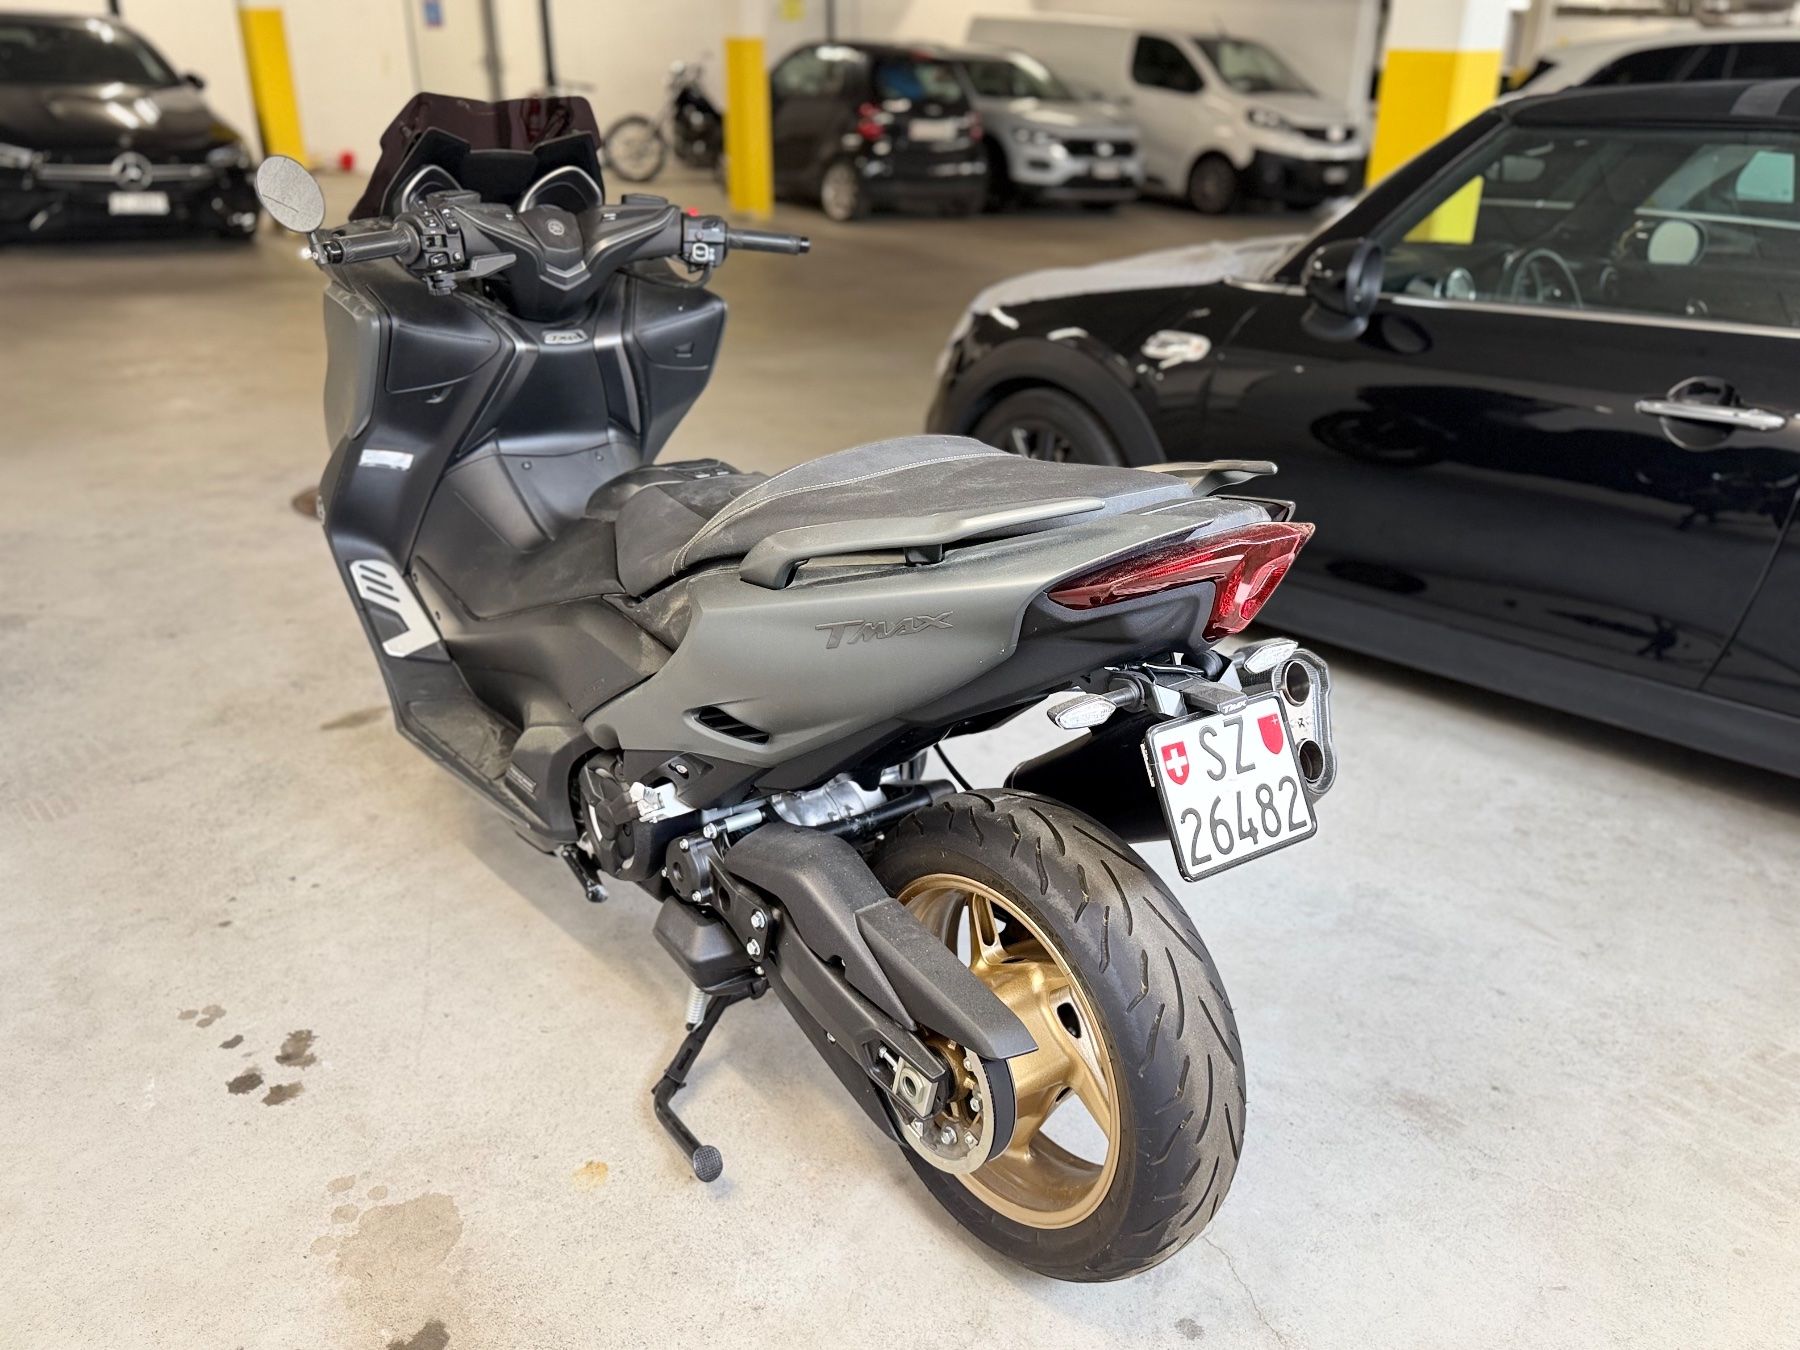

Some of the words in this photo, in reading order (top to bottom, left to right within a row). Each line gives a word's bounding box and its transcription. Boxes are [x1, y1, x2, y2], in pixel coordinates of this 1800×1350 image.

[814, 611, 954, 650] TMAX
[1199, 714, 1256, 781] SZ
[1180, 775, 1307, 867] 26482
